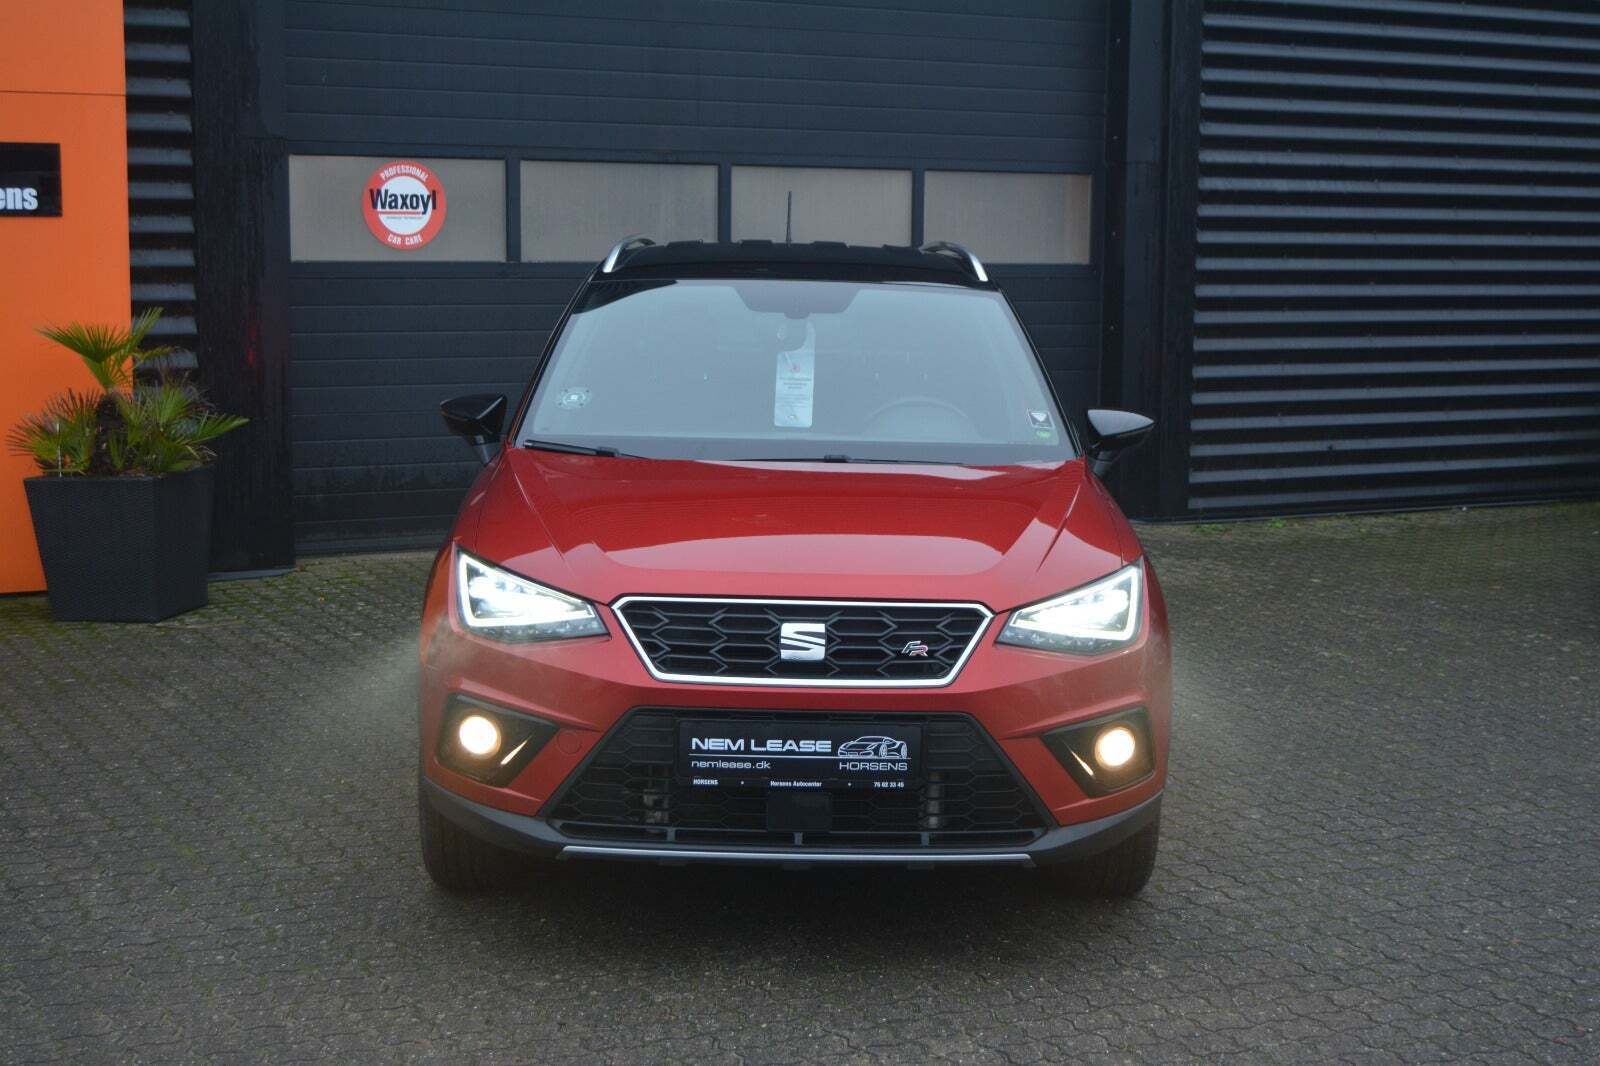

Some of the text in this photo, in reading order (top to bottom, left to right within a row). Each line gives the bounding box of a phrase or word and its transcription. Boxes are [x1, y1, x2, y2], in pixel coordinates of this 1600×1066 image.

[380, 165, 428, 181] PROFESSIONAL
[369, 188, 437, 215] Waxoyl
[388, 234, 422, 245] CAR CARE
[902, 640, 928, 656] FR
[692, 738, 832, 752] NEM LEASE
[692, 760, 771, 769] nemlease.dk
[839, 762, 907, 772] HORSENS
